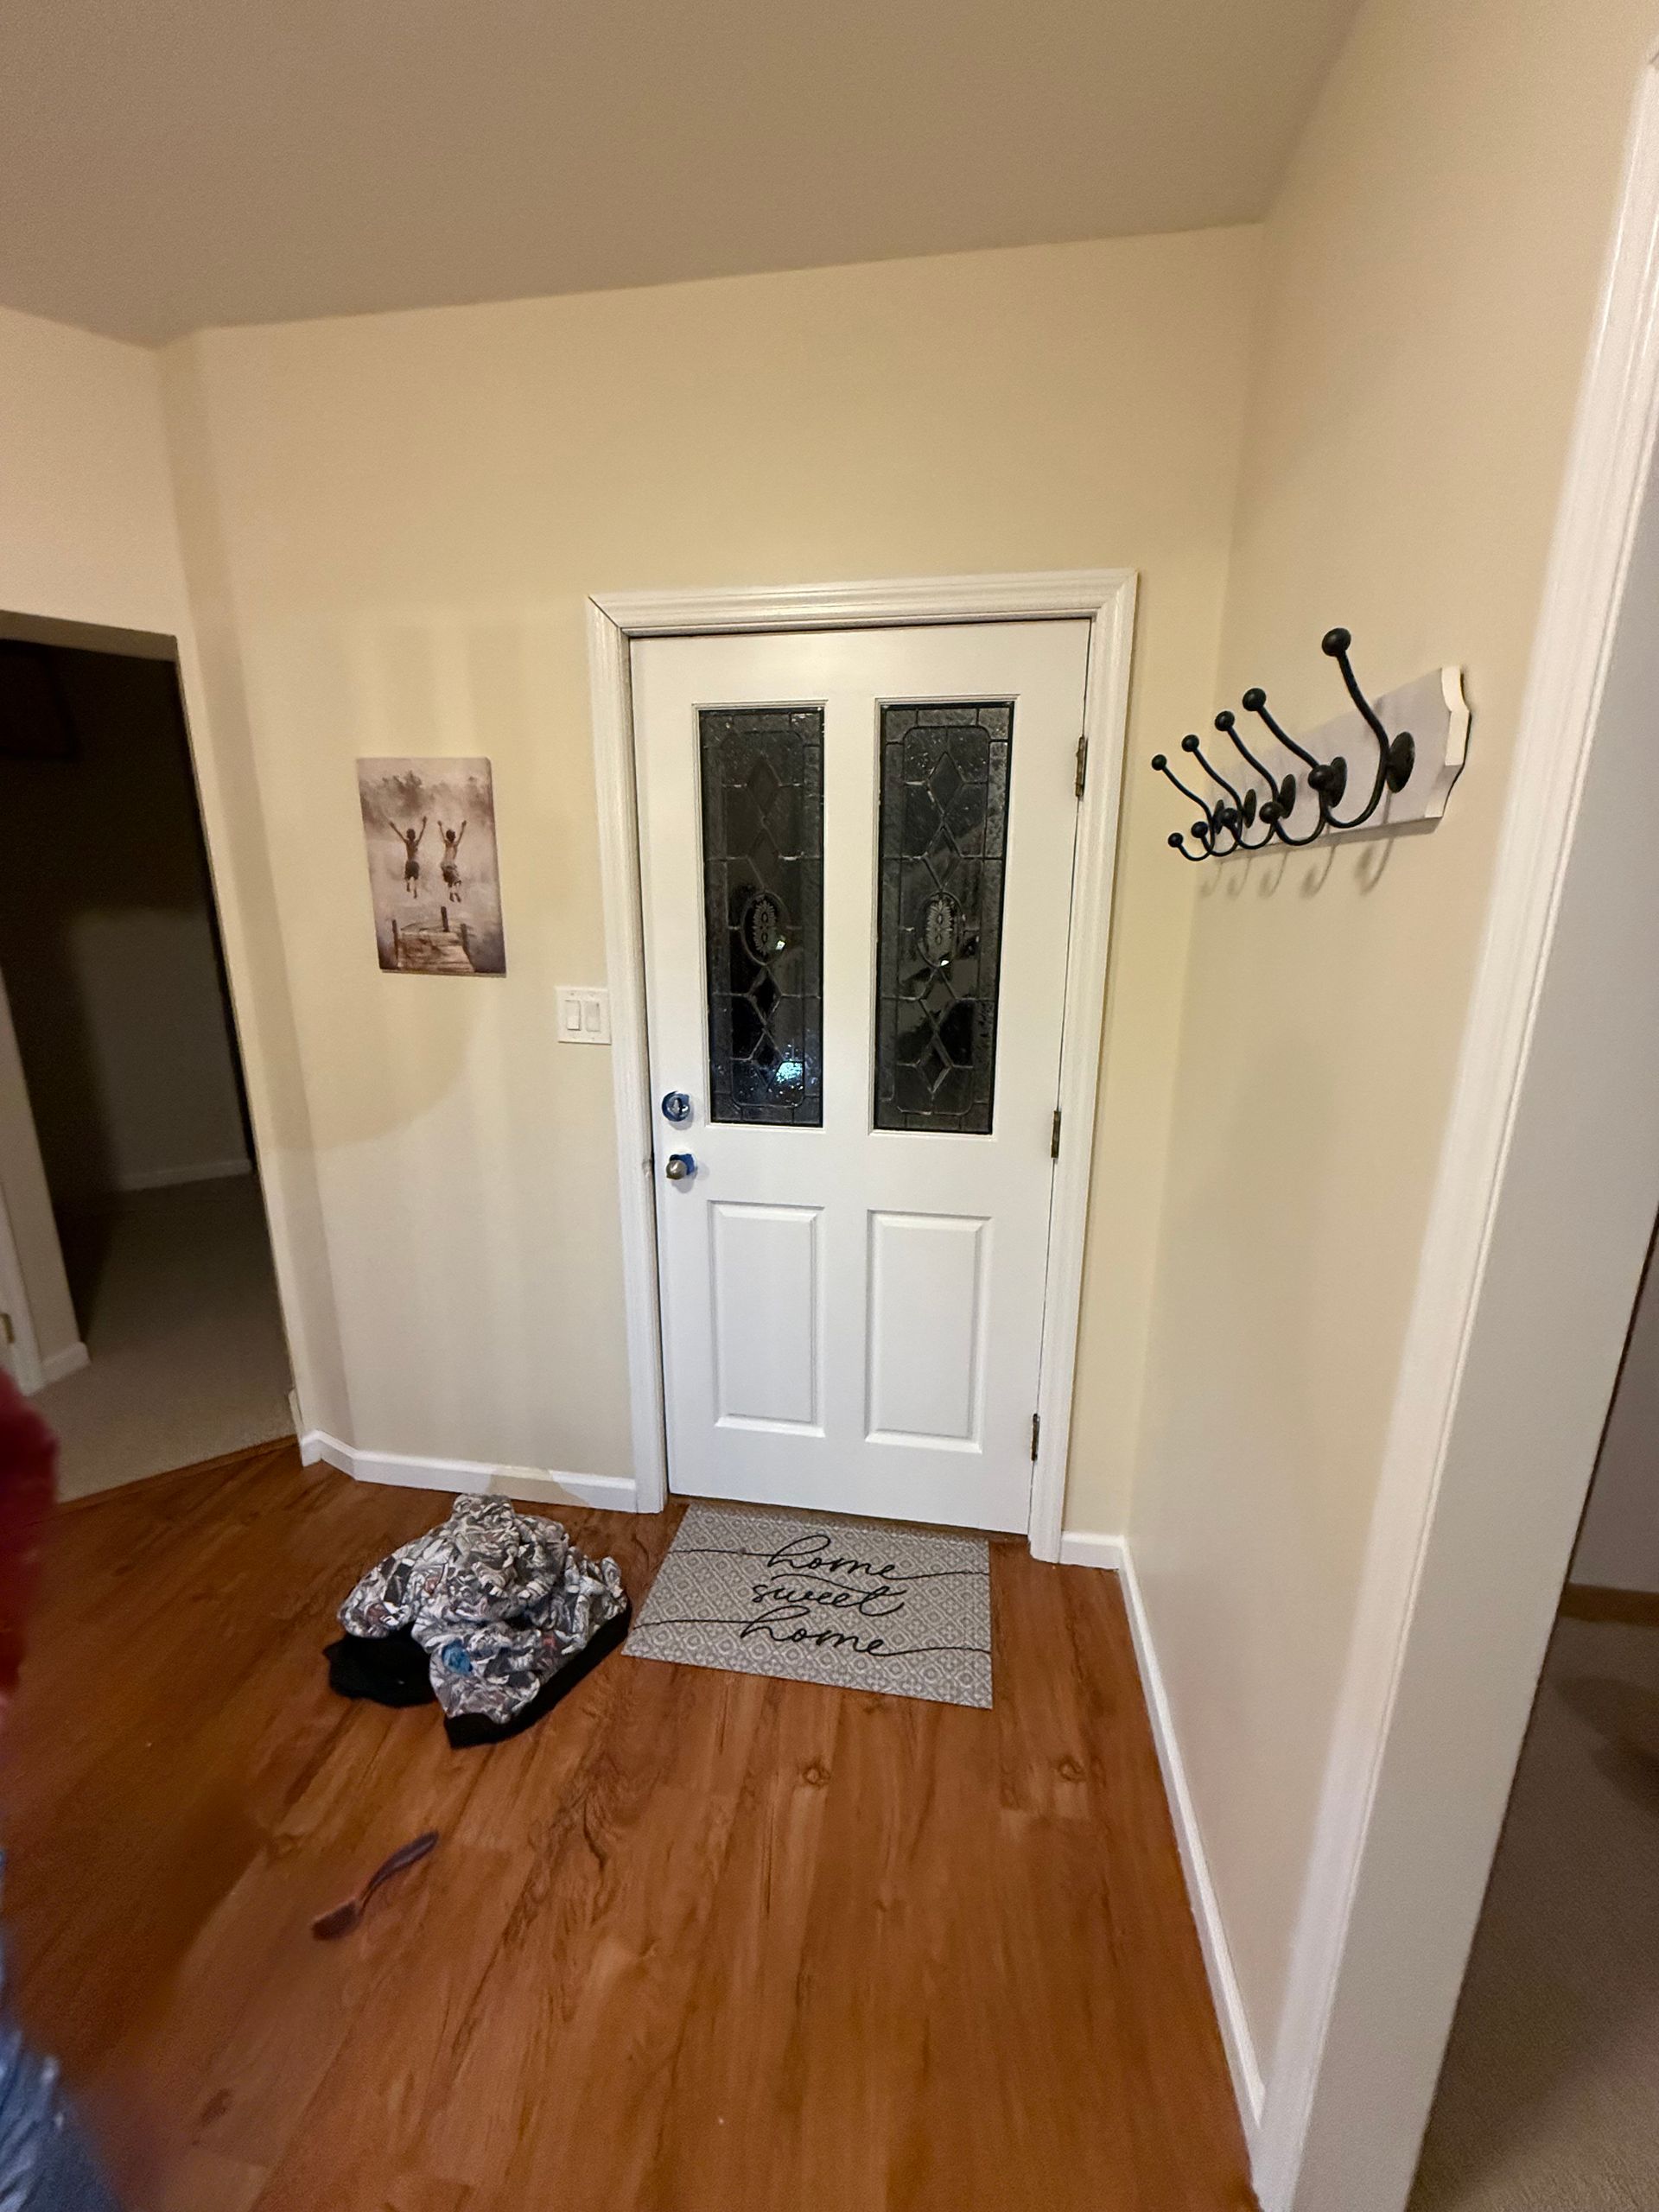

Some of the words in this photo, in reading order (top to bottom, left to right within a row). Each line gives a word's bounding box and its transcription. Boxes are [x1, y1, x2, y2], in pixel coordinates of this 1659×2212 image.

[766, 1534, 901, 1580] home
[750, 1573, 908, 1617] sweet
[740, 1605, 891, 1657] home
